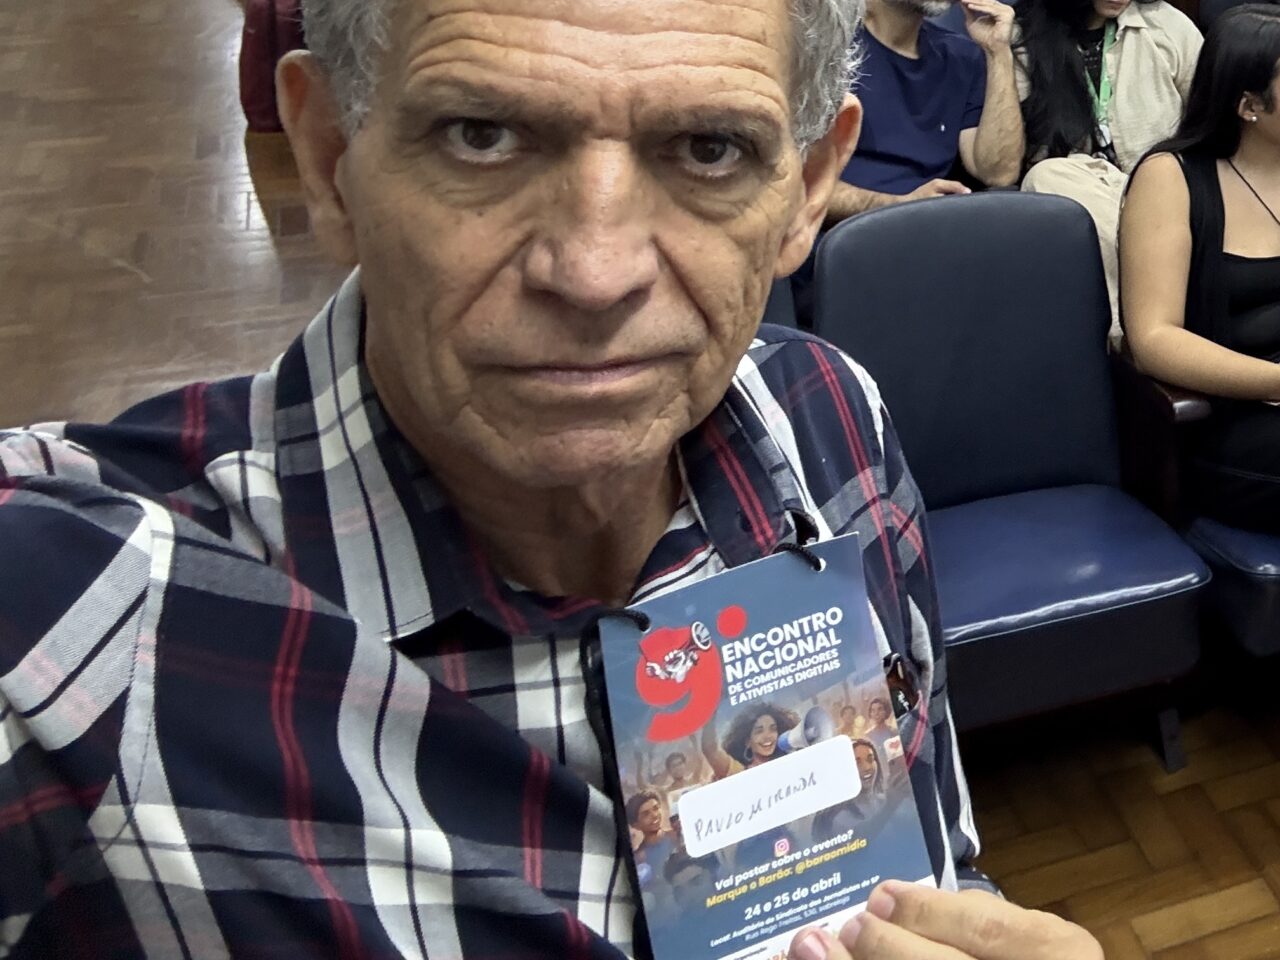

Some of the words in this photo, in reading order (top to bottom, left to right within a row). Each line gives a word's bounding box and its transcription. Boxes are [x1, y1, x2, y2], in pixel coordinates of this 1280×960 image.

[721, 606, 843, 664] ENCONTRO
[725, 627, 842, 683] NACIONAL
[728, 681, 744, 696] DE
[743, 648, 839, 690] COMUNICADORES
[730, 695, 738, 707] E
[738, 675, 794, 704] ATIVISTAS
[794, 659, 841, 683] DIGITAIS
[715, 876, 734, 891] Vai
[734, 861, 771, 887] postar
[771, 850, 802, 870] sobre
[811, 829, 854, 854] evento?
[706, 882, 748, 909] Marque
[744, 905, 761, 921] 24
[773, 892, 790, 910] 25
[791, 887, 809, 903] de
[810, 871, 842, 895] abril
